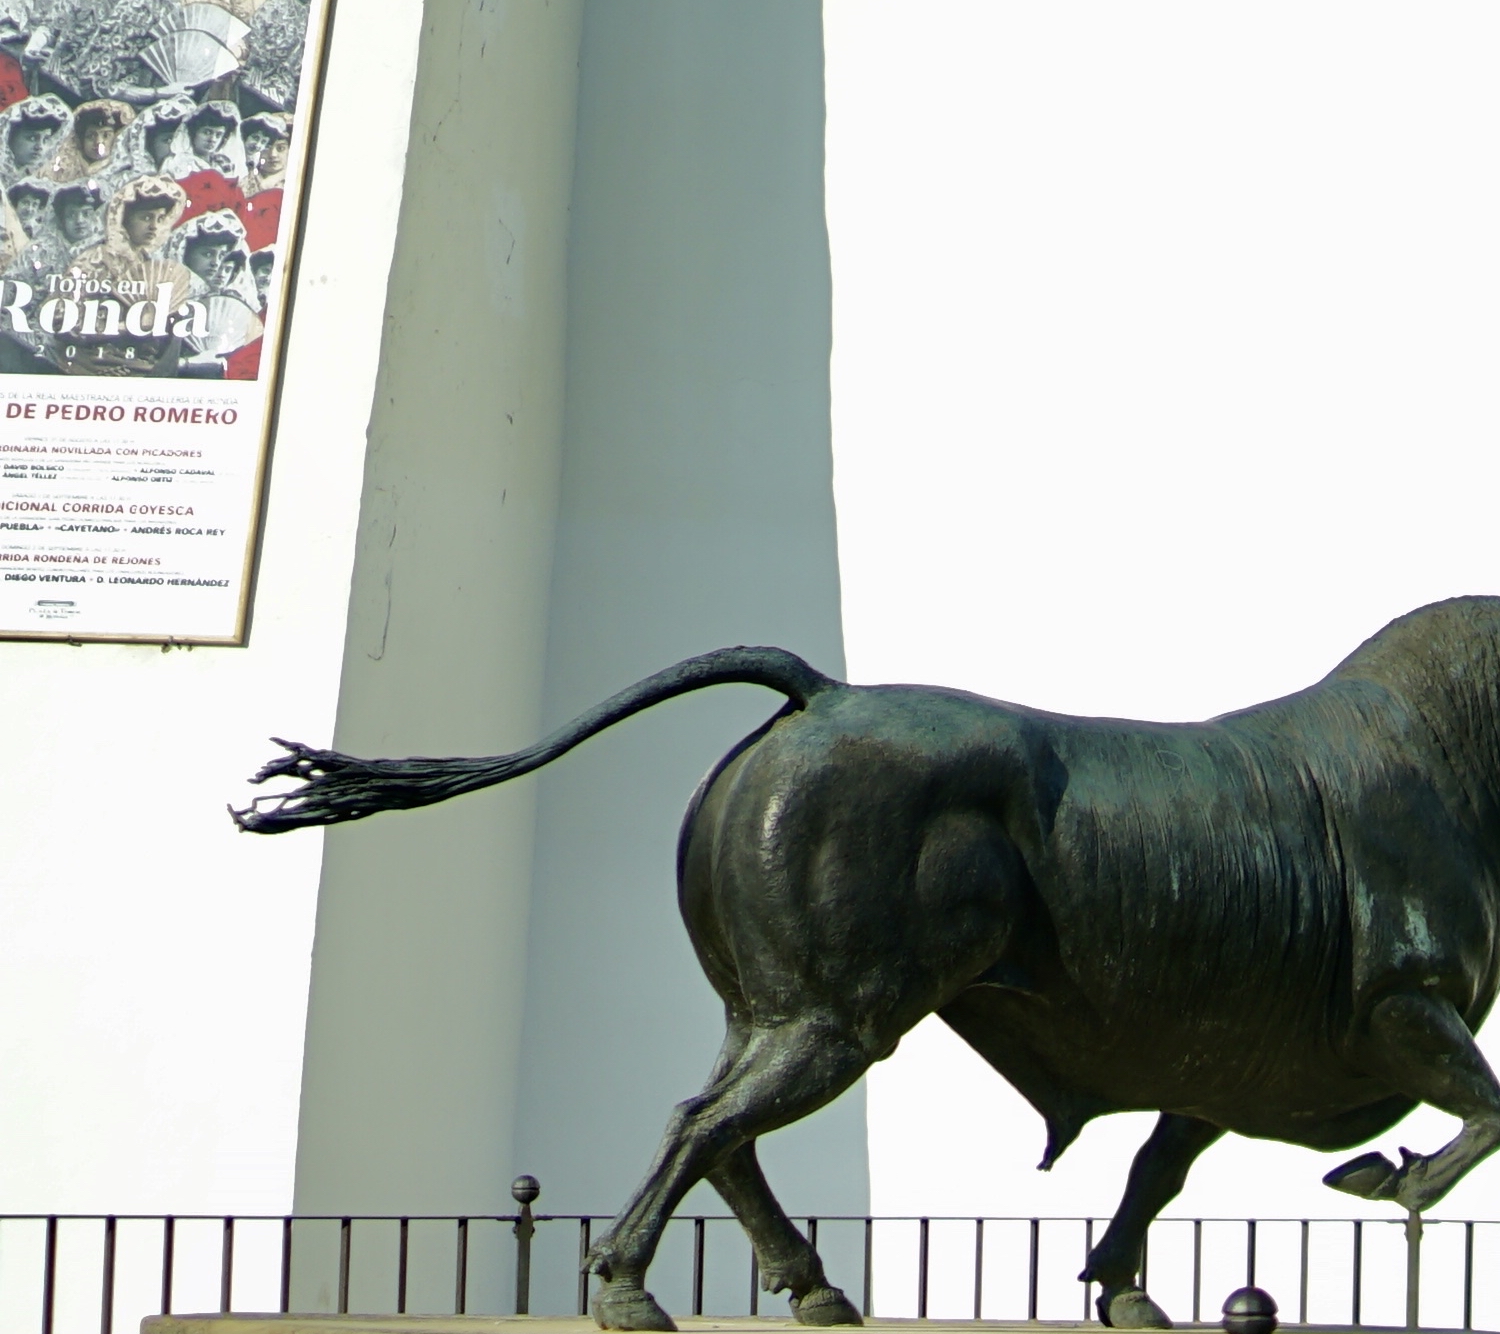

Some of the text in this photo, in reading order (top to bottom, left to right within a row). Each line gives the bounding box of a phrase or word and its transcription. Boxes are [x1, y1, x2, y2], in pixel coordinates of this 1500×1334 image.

[46, 274, 146, 295] Toros en
[6, 403, 238, 425] DE PEDRO ROMERO
[51, 447, 112, 455] NOVILLADA
[115, 448, 139, 456] CON
[142, 449, 202, 458] PICADORES
[62, 502, 124, 514] CORRIDA
[129, 504, 194, 516] GOYESCA
[131, 525, 172, 535] ANDRÉS
[175, 527, 203, 535] ROCA
[206, 528, 226, 536] REY
[93, 556, 107, 564] DE
[112, 556, 161, 566] REJONES
[5, 573, 36, 582] DIEGO
[39, 574, 86, 583] VENTURA
[109, 576, 164, 586] LEONARDO
[167, 578, 230, 587] HERNÁNDEZ
